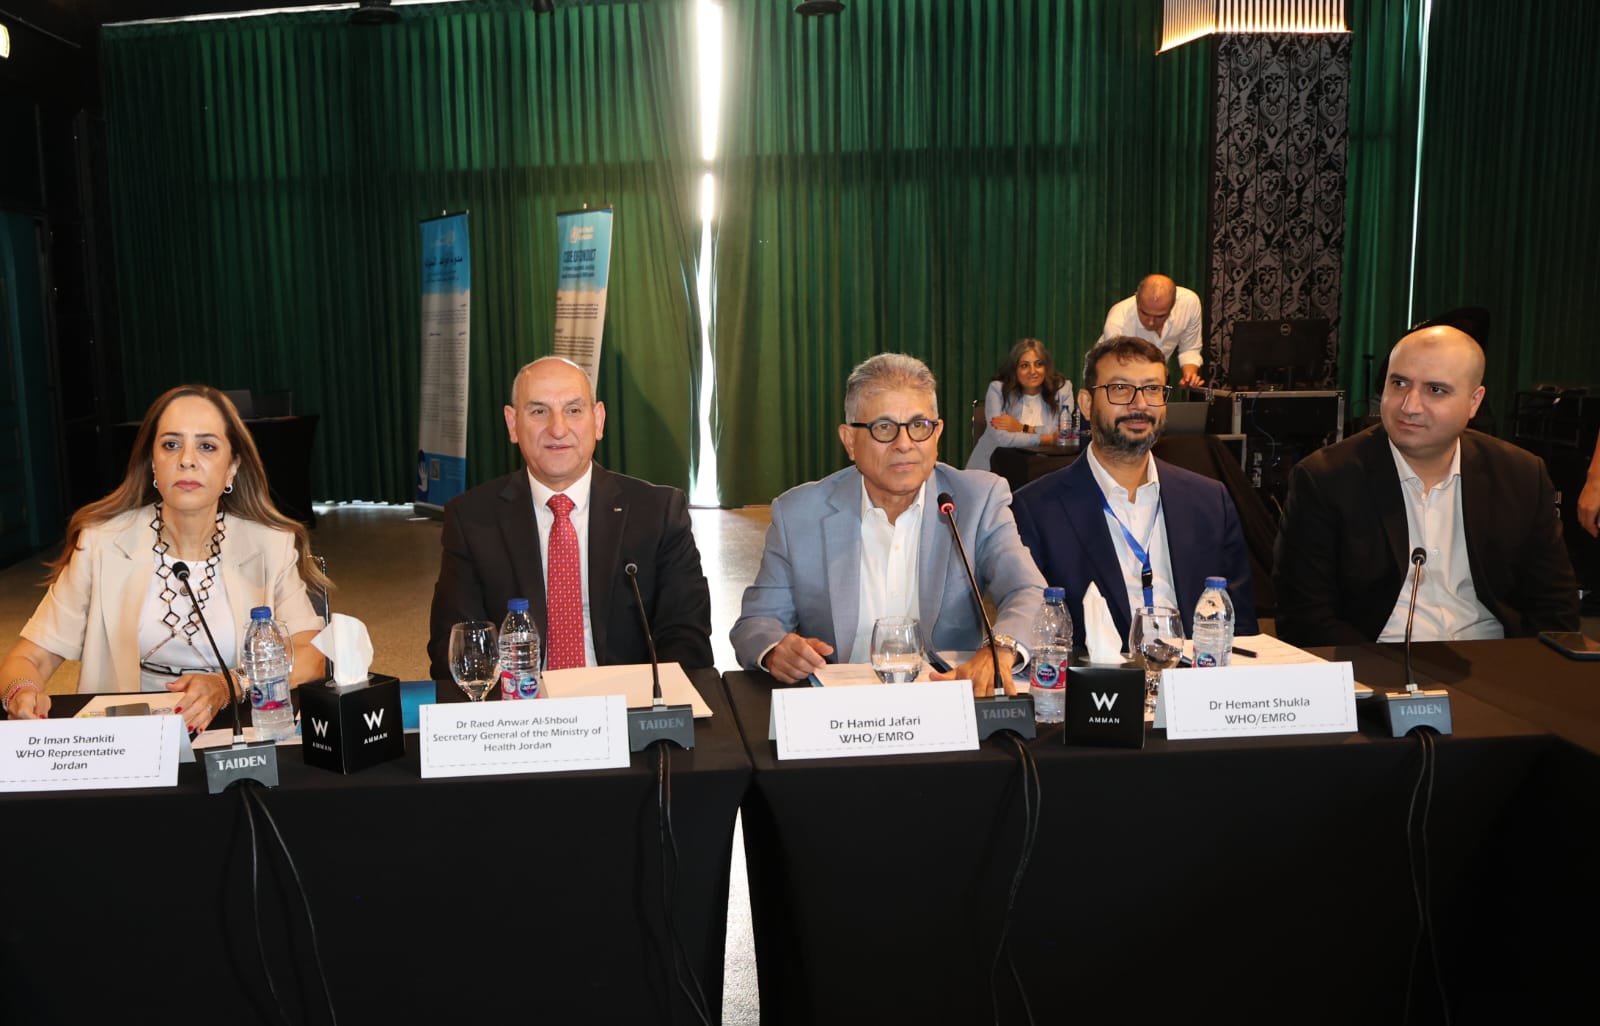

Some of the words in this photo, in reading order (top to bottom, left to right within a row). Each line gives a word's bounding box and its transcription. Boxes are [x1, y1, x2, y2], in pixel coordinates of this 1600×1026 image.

[1091, 692, 1119, 711] W
[1209, 700, 1222, 710] Dr
[1226, 699, 1270, 710] Hemant
[1273, 697, 1310, 708] Shukla
[982, 708, 1026, 720] TAIDEN
[1400, 703, 1442, 716] TAIDEN
[363, 708, 384, 730] W
[456, 720, 468, 729] Dr
[470, 720, 494, 728] Raed
[497, 718, 528, 727] Anwar
[532, 716, 578, 726] Al-Shboul
[639, 718, 686, 731] TAIDEN
[830, 720, 844, 730] Dr
[847, 718, 886, 728] Hamid
[889, 716, 921, 726] Jafari
[1225, 712, 1296, 726] WHO/EMRO
[312, 717, 328, 738] W
[28, 736, 40, 746] Dr
[44, 736, 70, 744] Iman
[73, 734, 115, 744] Shankiti
[364, 732, 388, 745] AMMAN
[433, 733, 477, 743] Secretary
[480, 730, 518, 740] General
[520, 730, 530, 738] of
[532, 729, 548, 738] the
[550, 728, 588, 738] Ministry
[592, 726, 602, 736] of
[839, 731, 914, 744] WHO/EMRO
[484, 743, 516, 752] Health
[518, 741, 552, 751] Jordan
[16, 750, 45, 759] WHO
[48, 747, 126, 760] Representative
[51, 761, 88, 771] Jordan
[216, 755, 267, 771] TAIDEN
